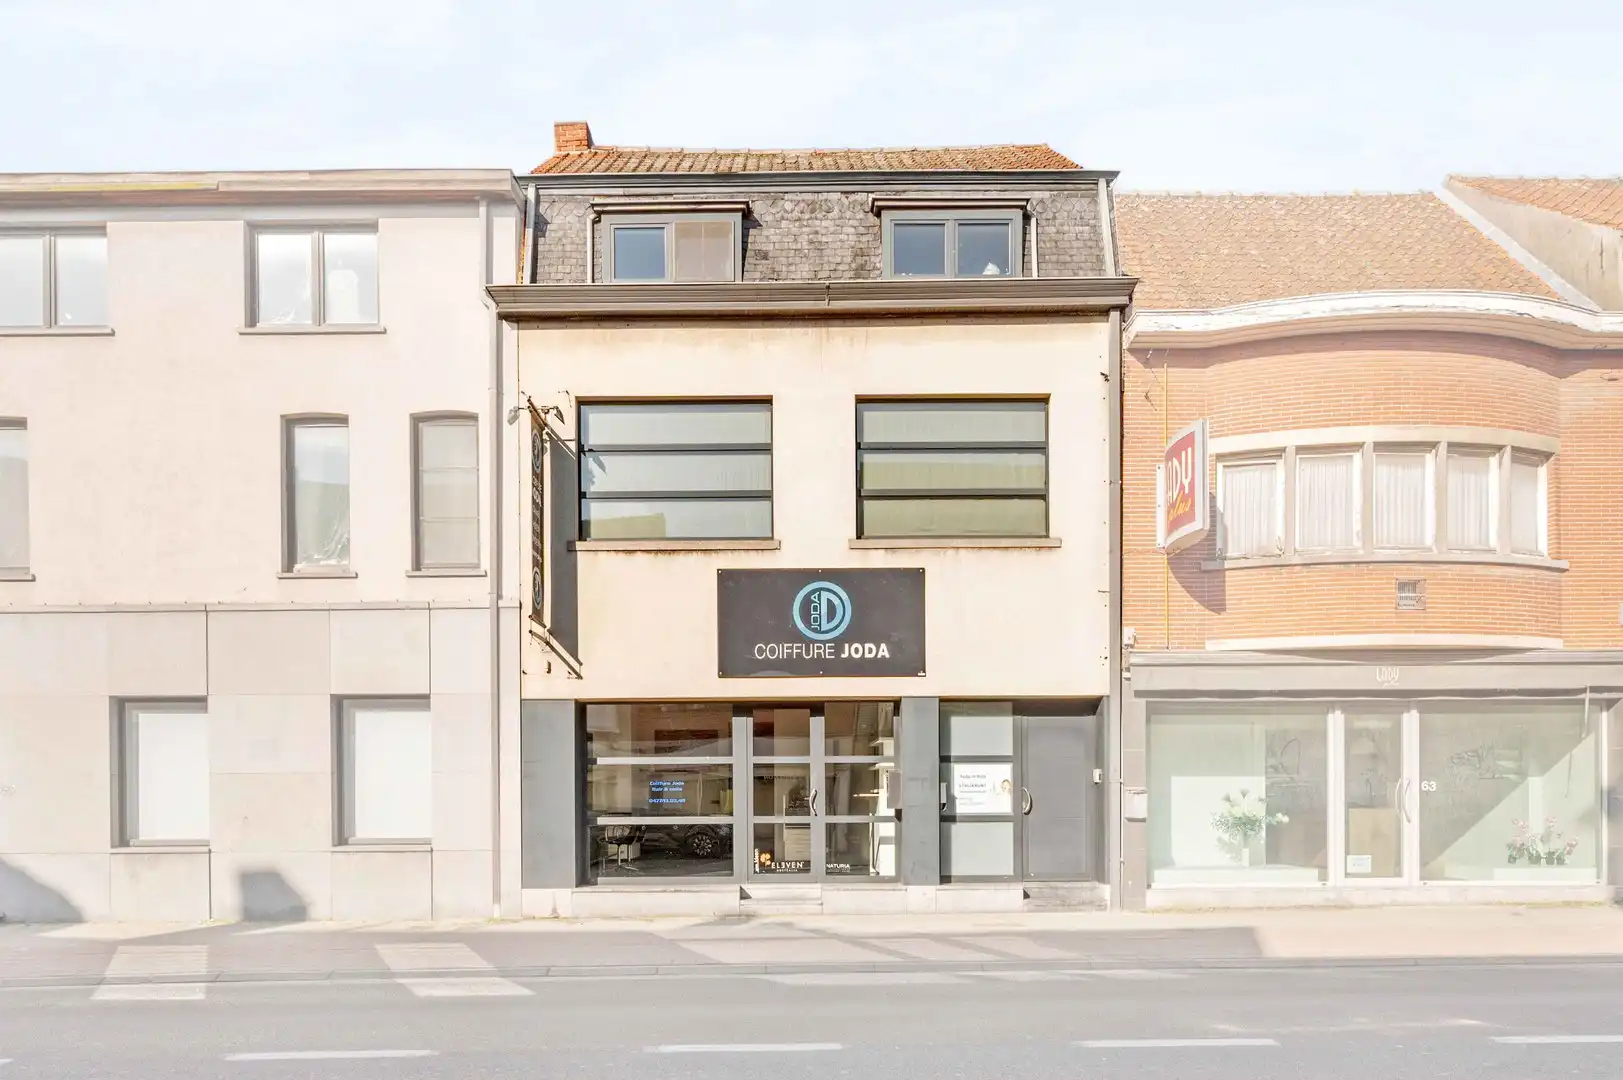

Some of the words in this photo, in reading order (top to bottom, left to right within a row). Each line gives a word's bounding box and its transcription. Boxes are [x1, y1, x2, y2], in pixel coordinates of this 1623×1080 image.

[1167, 446, 1192, 506] ADY
[811, 591, 820, 631] JODA
[754, 643, 836, 660] COIFFURE
[840, 643, 891, 659] JODA
[1421, 780, 1437, 792] 63
